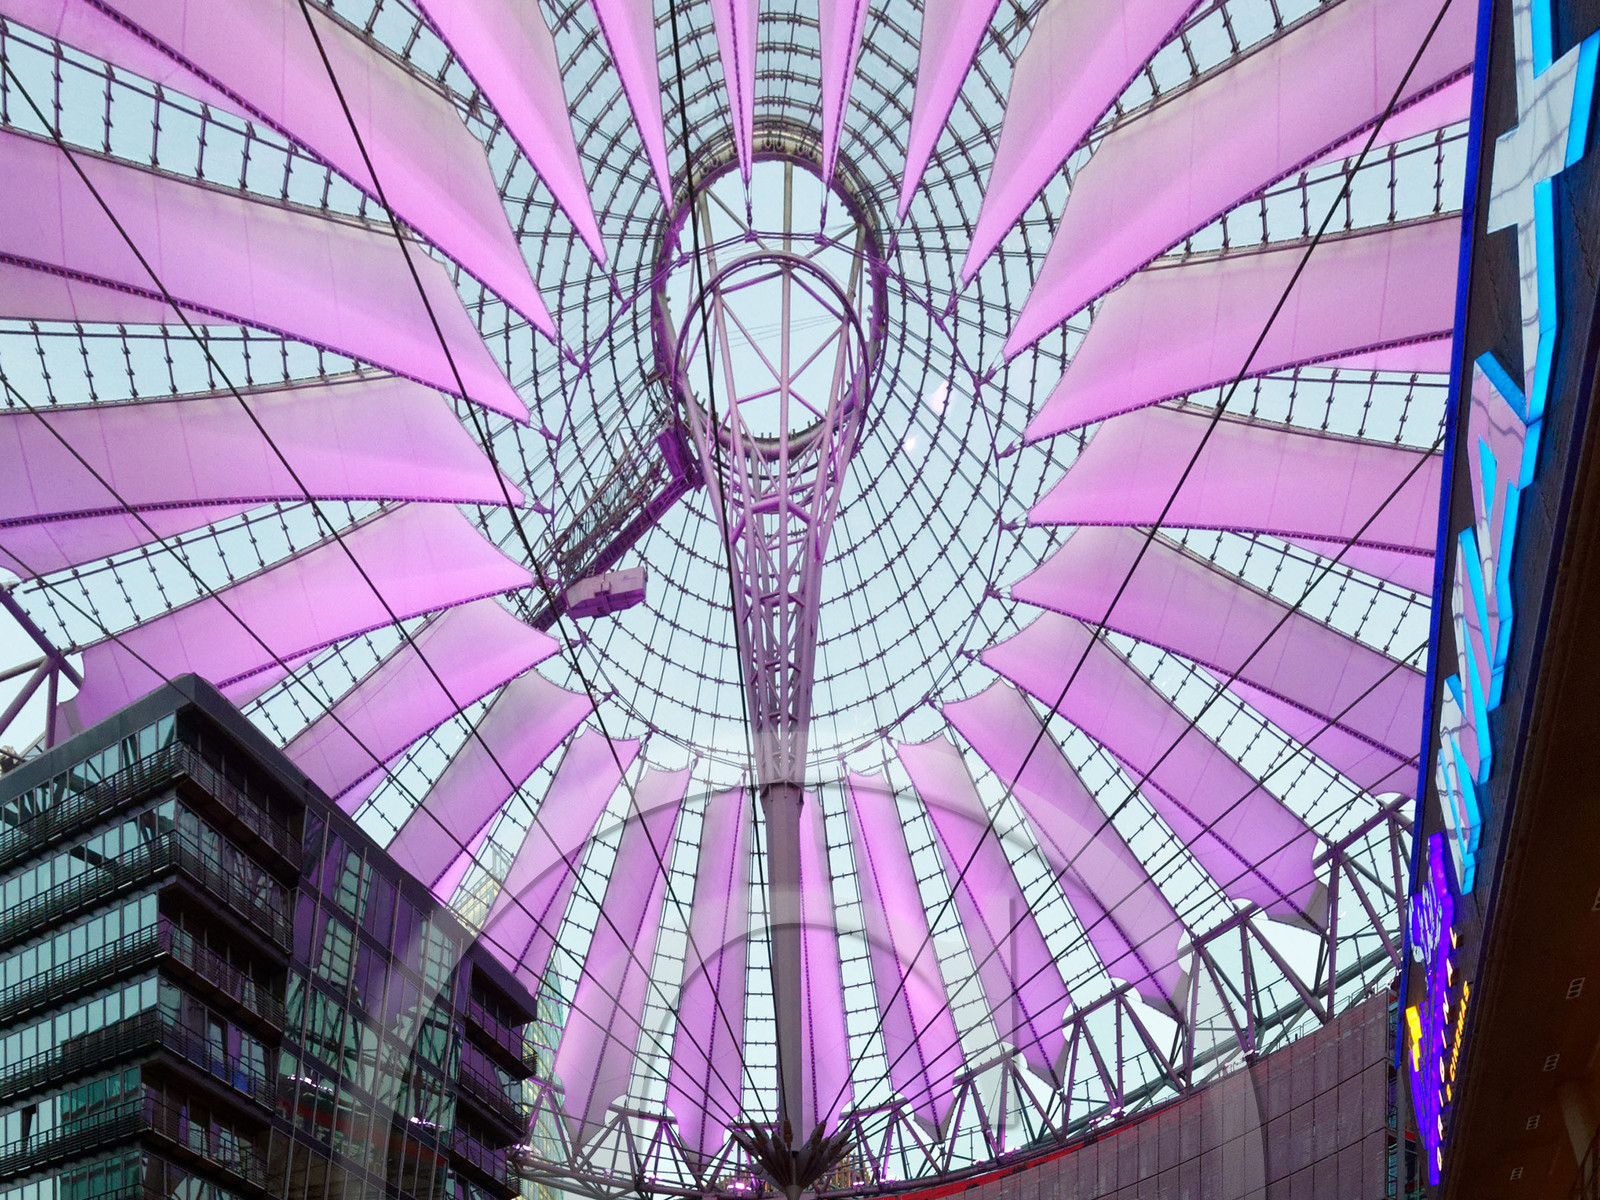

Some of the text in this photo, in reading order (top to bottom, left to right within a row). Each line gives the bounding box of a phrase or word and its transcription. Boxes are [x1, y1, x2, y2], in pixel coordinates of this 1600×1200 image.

[1435, 0, 1600, 895] IMAX
[1436, 926, 1458, 1172] ORIGINAL
[1449, 980, 1471, 1082] CINEMAS
